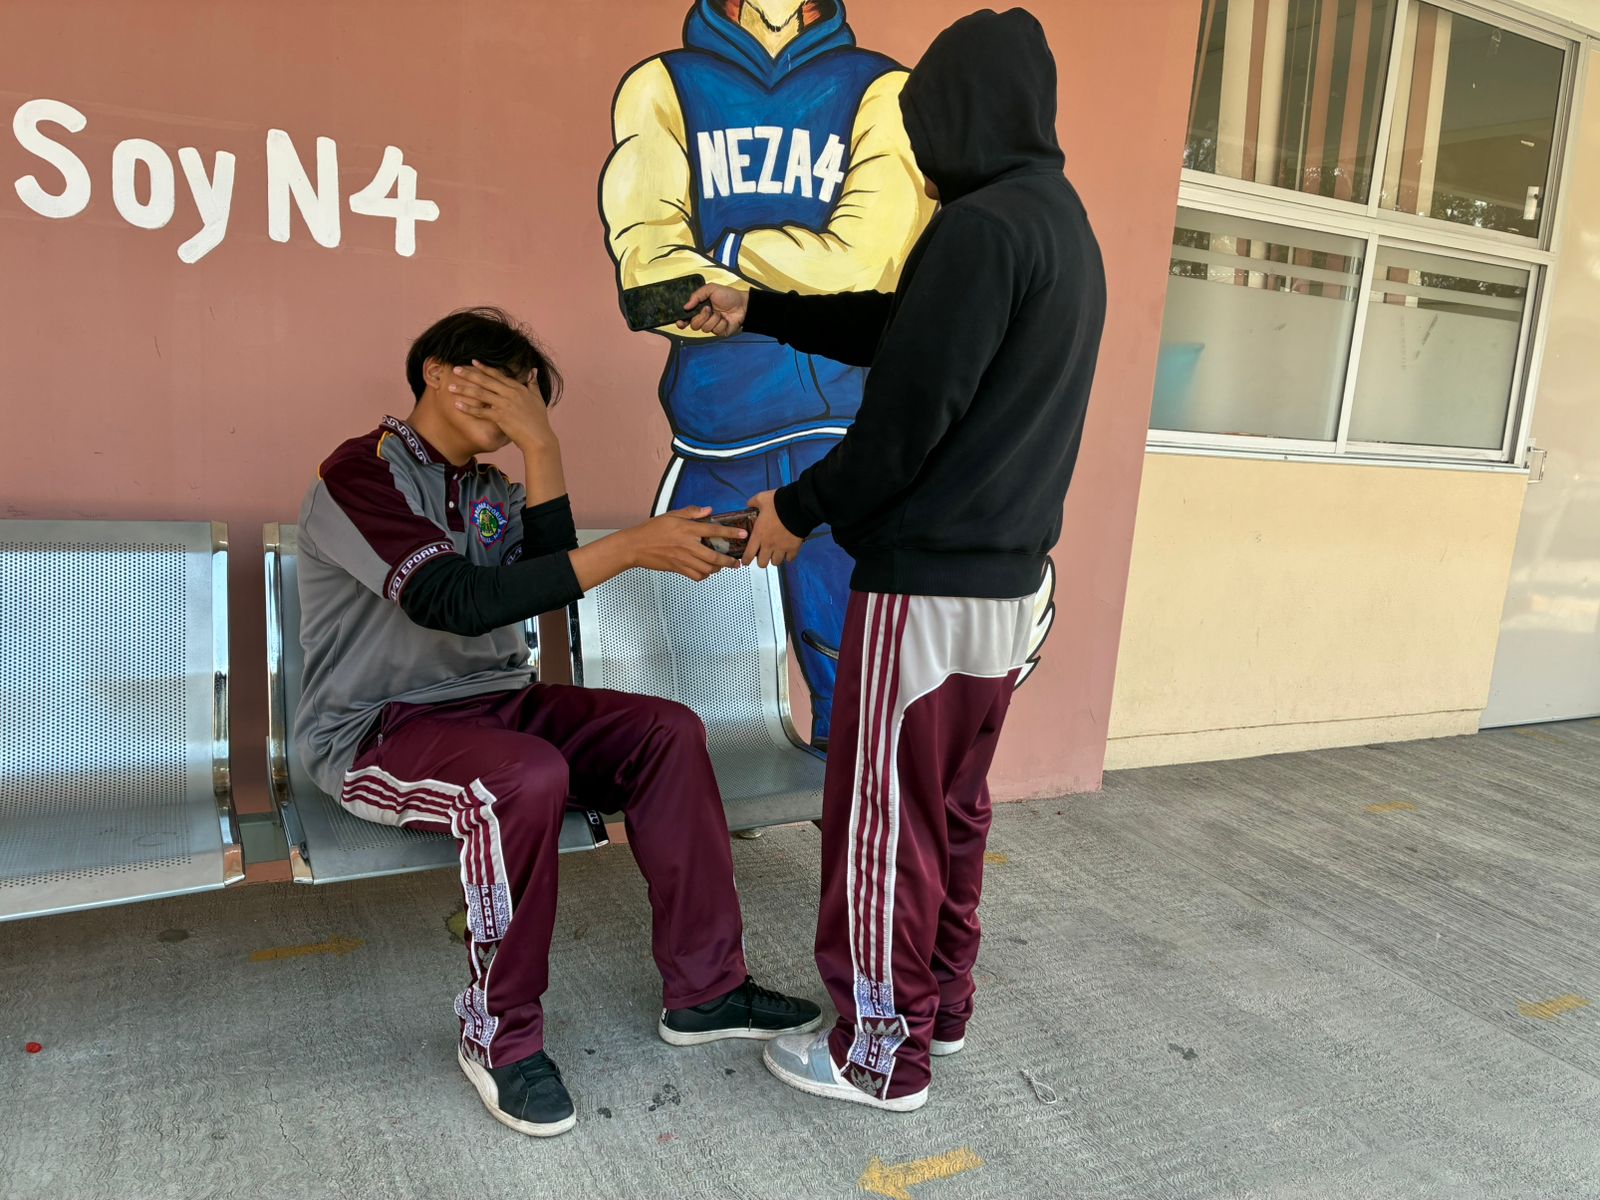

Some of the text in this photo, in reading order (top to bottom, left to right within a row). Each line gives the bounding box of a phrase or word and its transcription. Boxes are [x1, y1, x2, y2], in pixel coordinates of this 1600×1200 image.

[13, 98, 440, 264] Soy N4
[697, 126, 846, 203] NEZA4
[400, 546, 439, 575] EPOAN
[480, 884, 496, 938] POAN4
